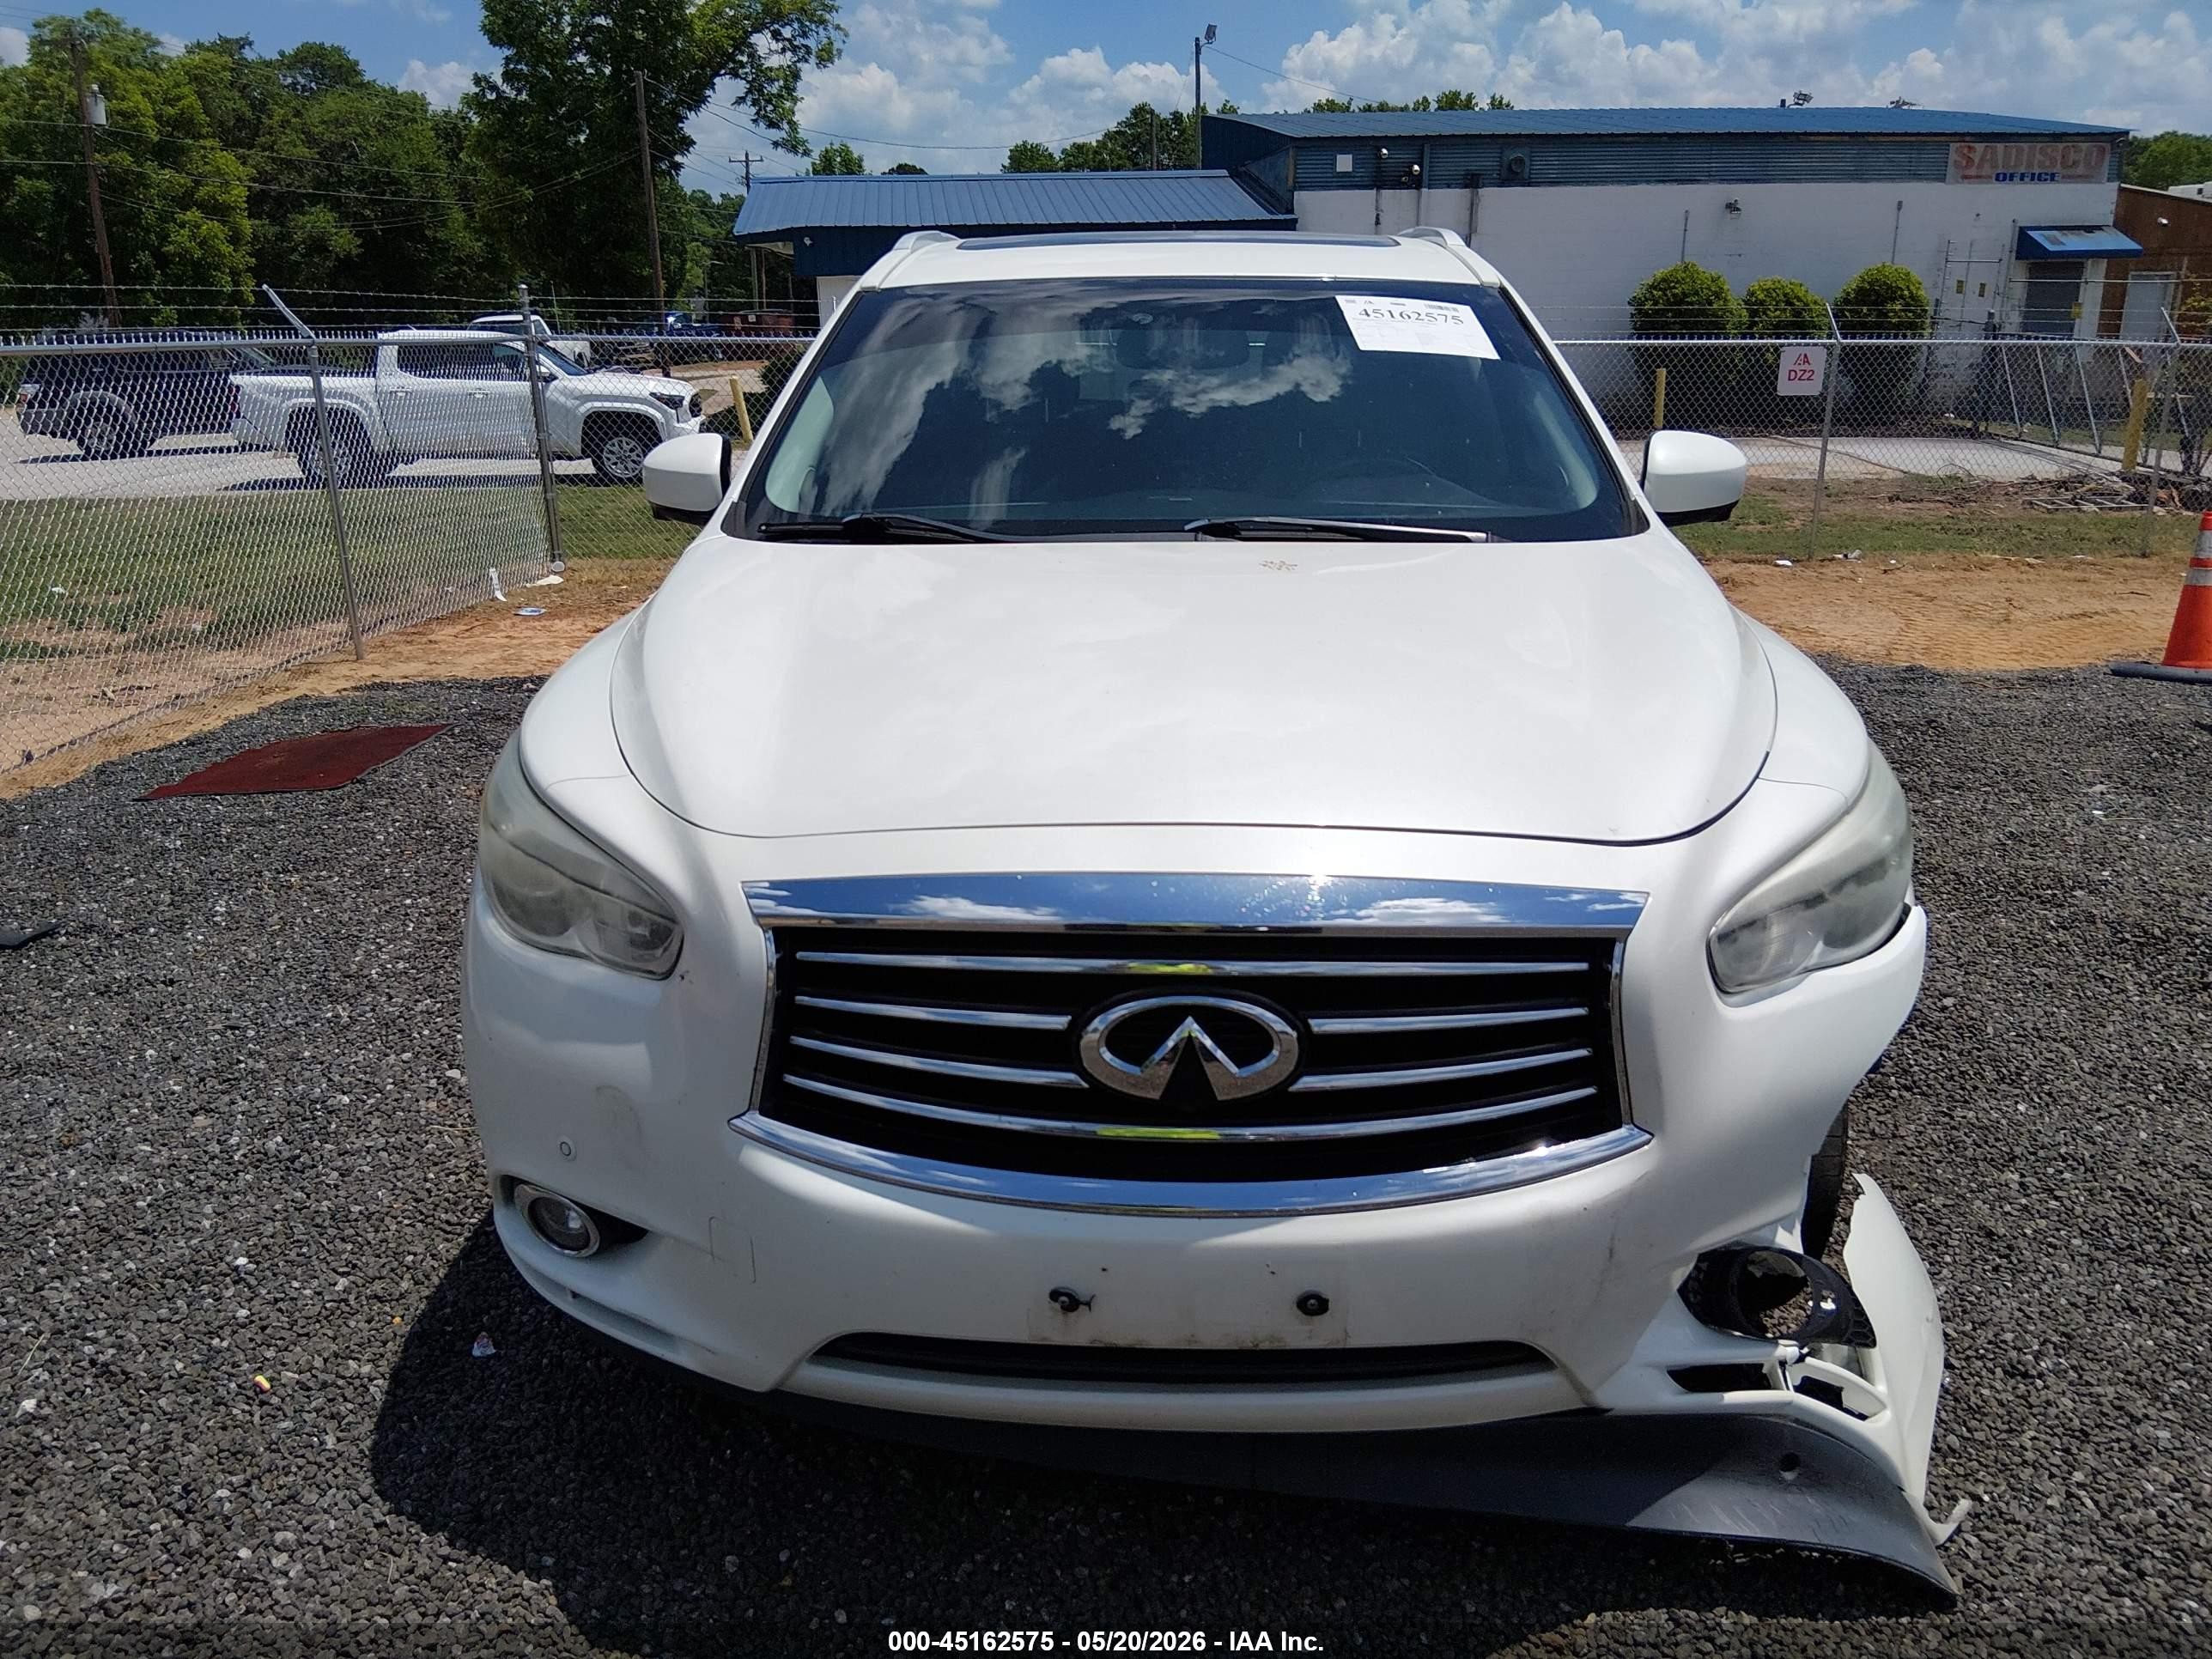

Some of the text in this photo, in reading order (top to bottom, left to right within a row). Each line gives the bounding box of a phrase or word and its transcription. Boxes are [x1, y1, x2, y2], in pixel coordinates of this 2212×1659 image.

[1954, 143, 2108, 171] SADISCO
[1995, 172, 2061, 182] OFFICE
[1358, 307, 1464, 325] 45162575
[1788, 369, 1814, 381] DZ2
